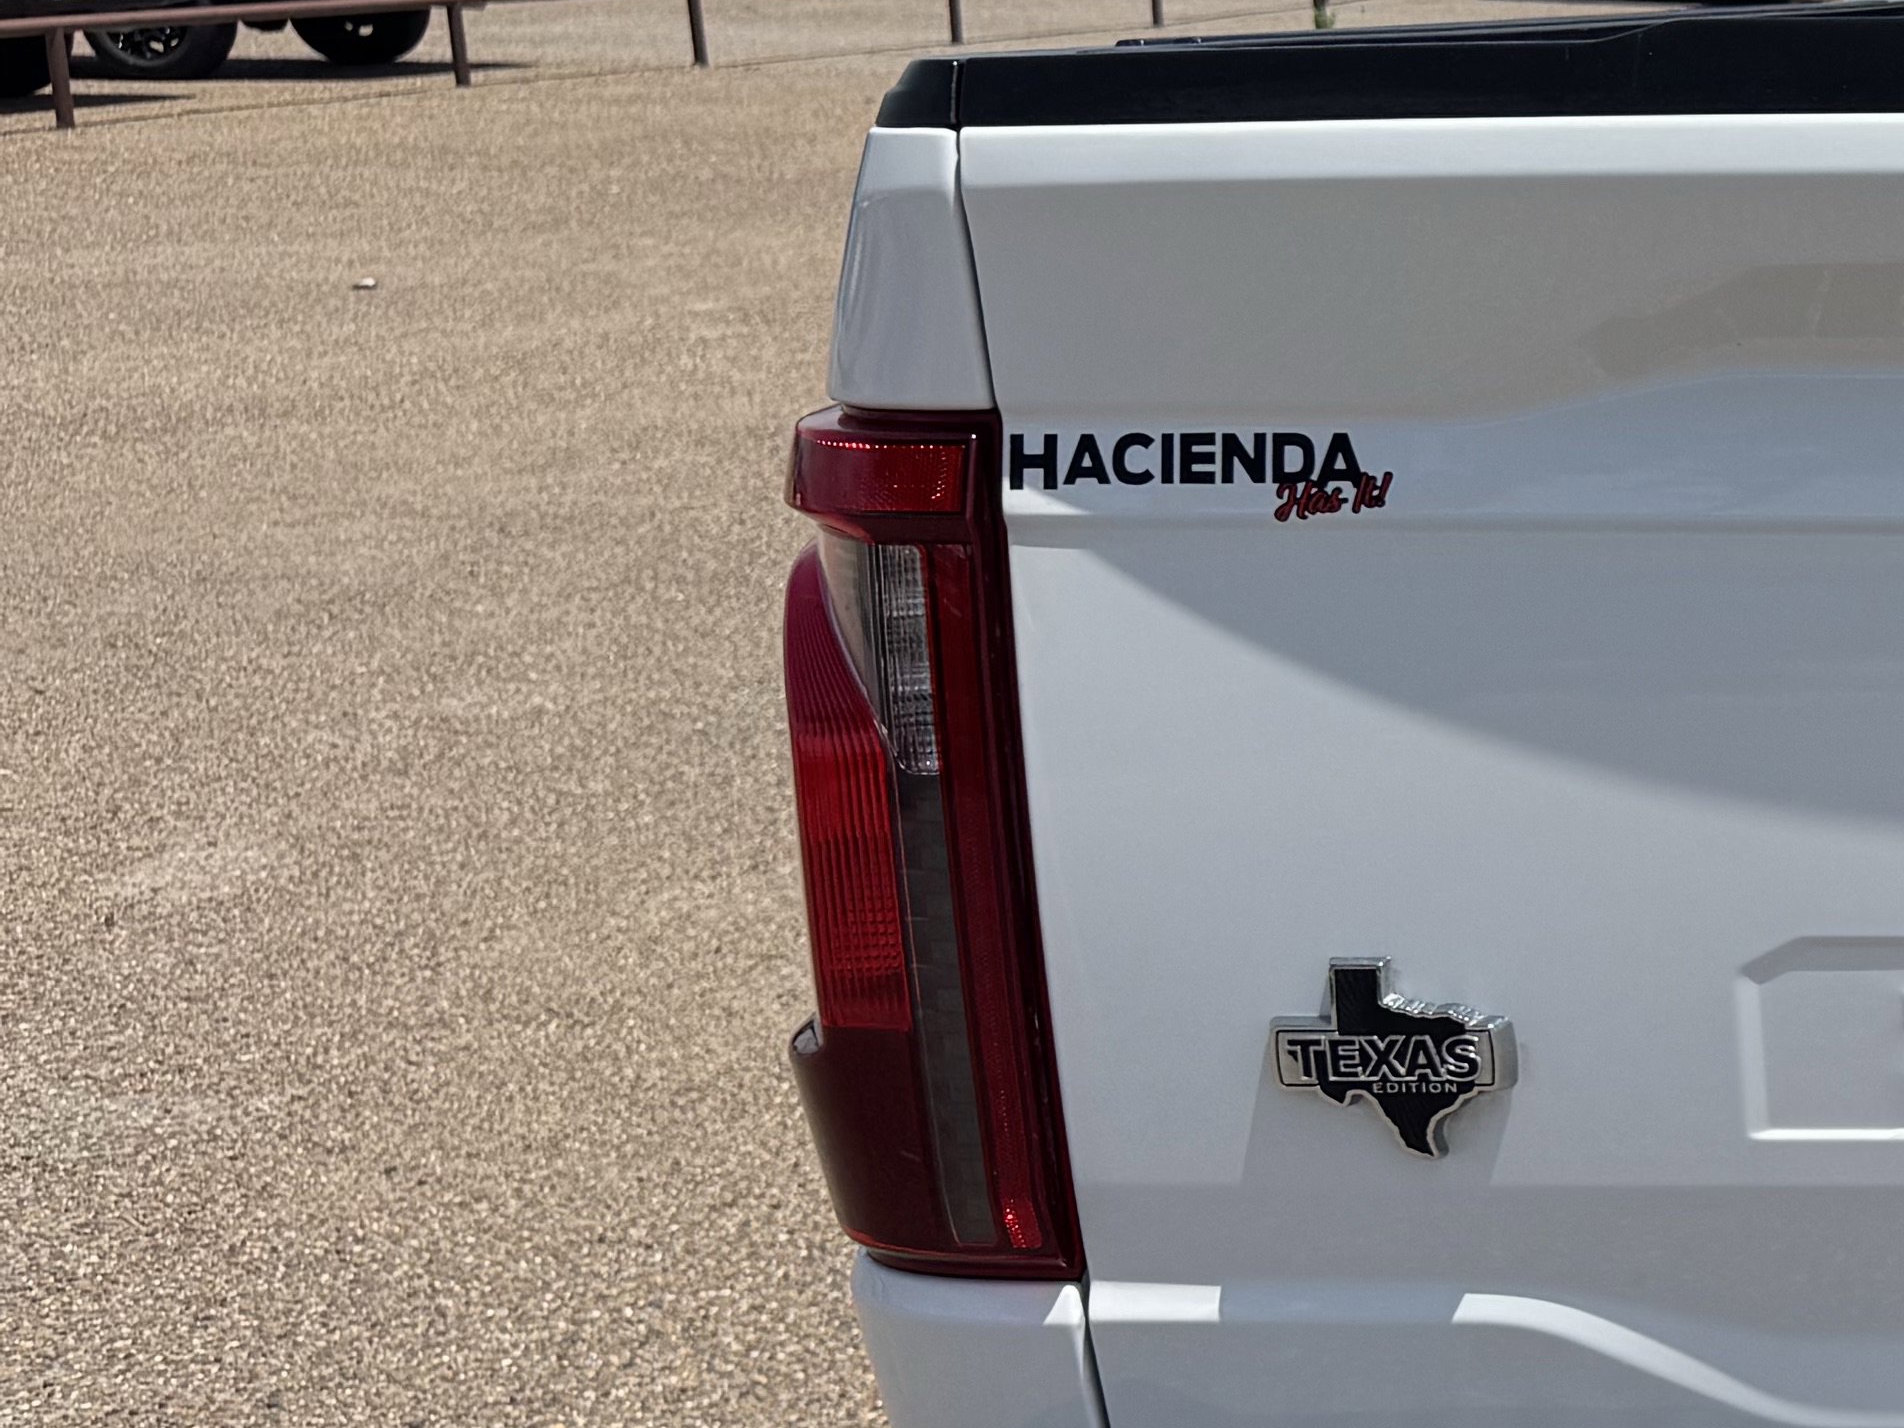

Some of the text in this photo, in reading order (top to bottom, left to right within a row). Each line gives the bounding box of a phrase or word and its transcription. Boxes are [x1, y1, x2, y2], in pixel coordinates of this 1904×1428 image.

[1008, 431, 1361, 490] HACIENDA
[1274, 479, 1349, 522] Has
[1286, 1034, 1482, 1082] TEXAS
[1372, 1082, 1458, 1094] EDITION
